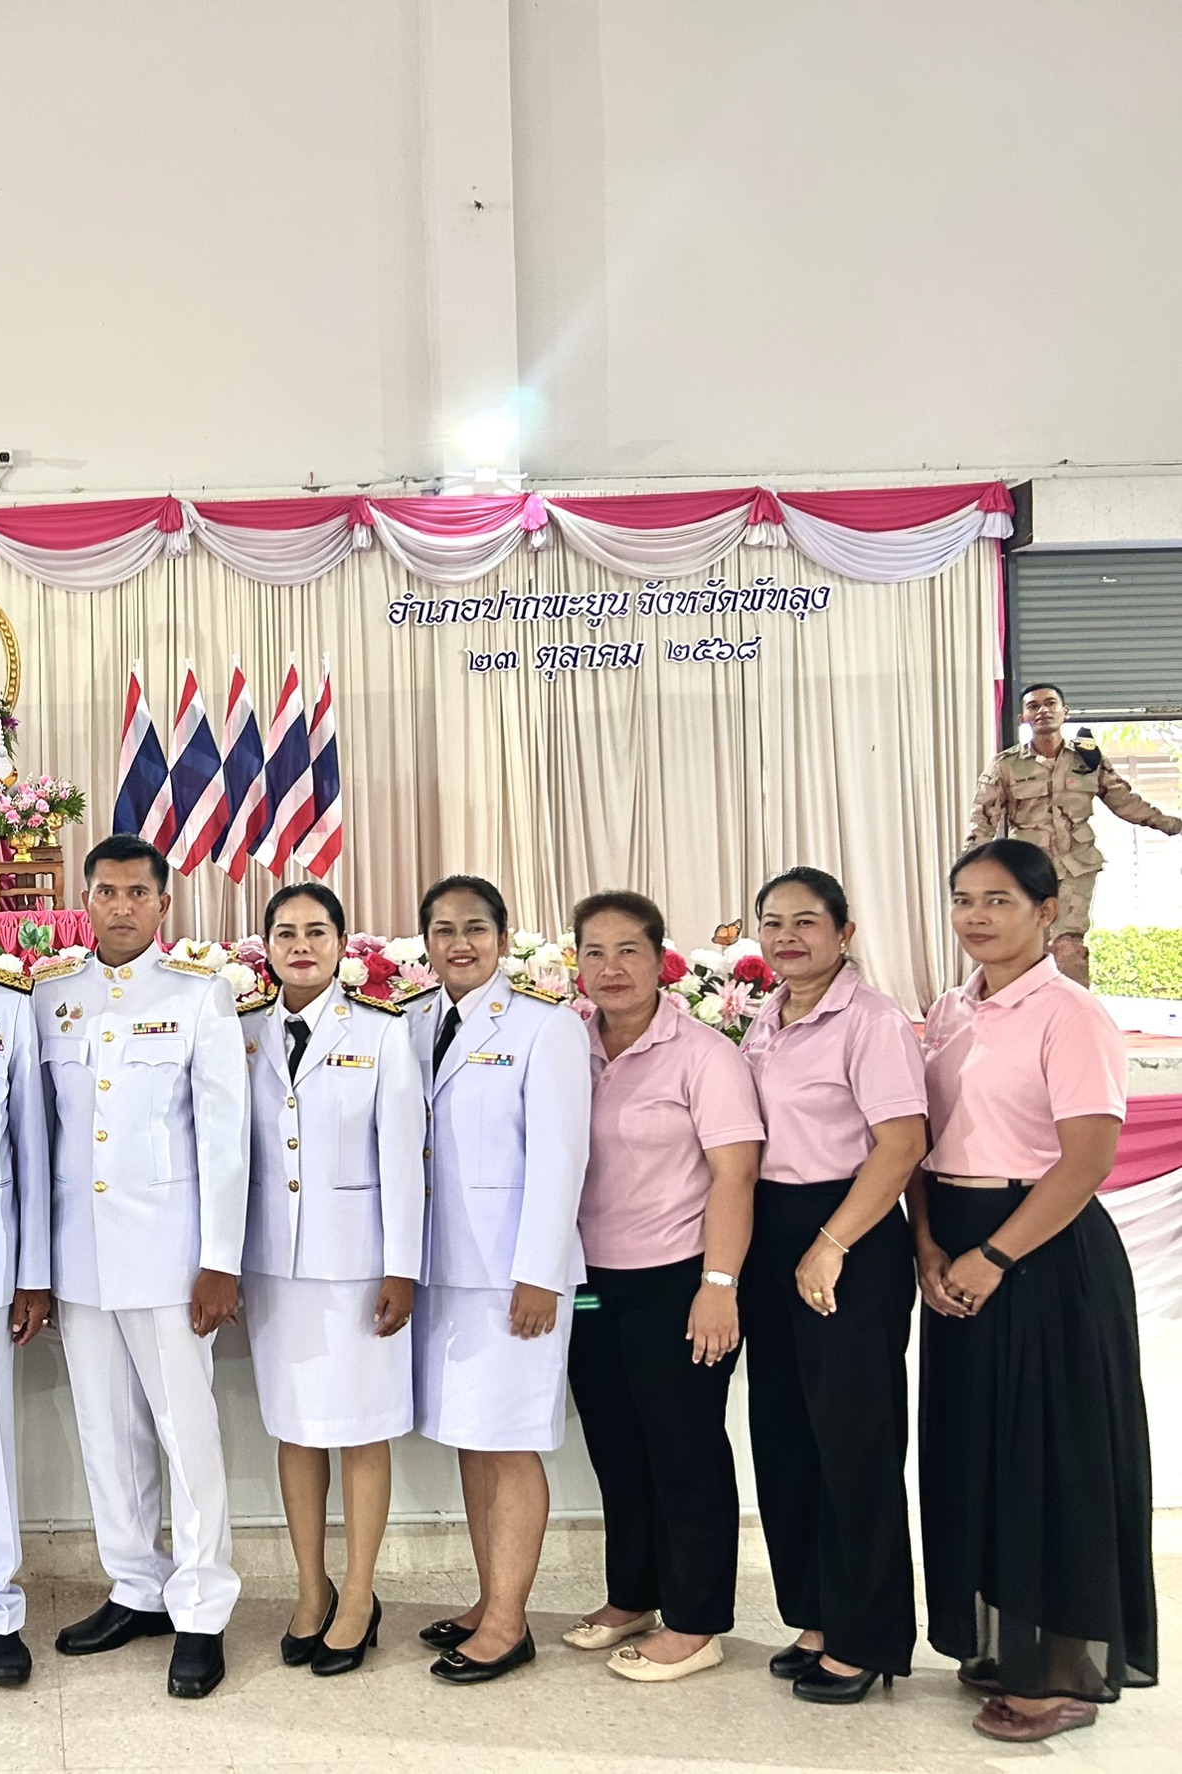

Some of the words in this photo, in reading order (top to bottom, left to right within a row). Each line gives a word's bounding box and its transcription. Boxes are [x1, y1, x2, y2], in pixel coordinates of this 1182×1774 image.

[389, 590, 631, 627] อำเภอปากพะยูน
[637, 577, 832, 621] จังหวัดพัทลุง
[468, 649, 519, 672] ๒๓
[535, 642, 644, 681] ตุลาคม
[665, 636, 762, 664] ๒๕๖๘
